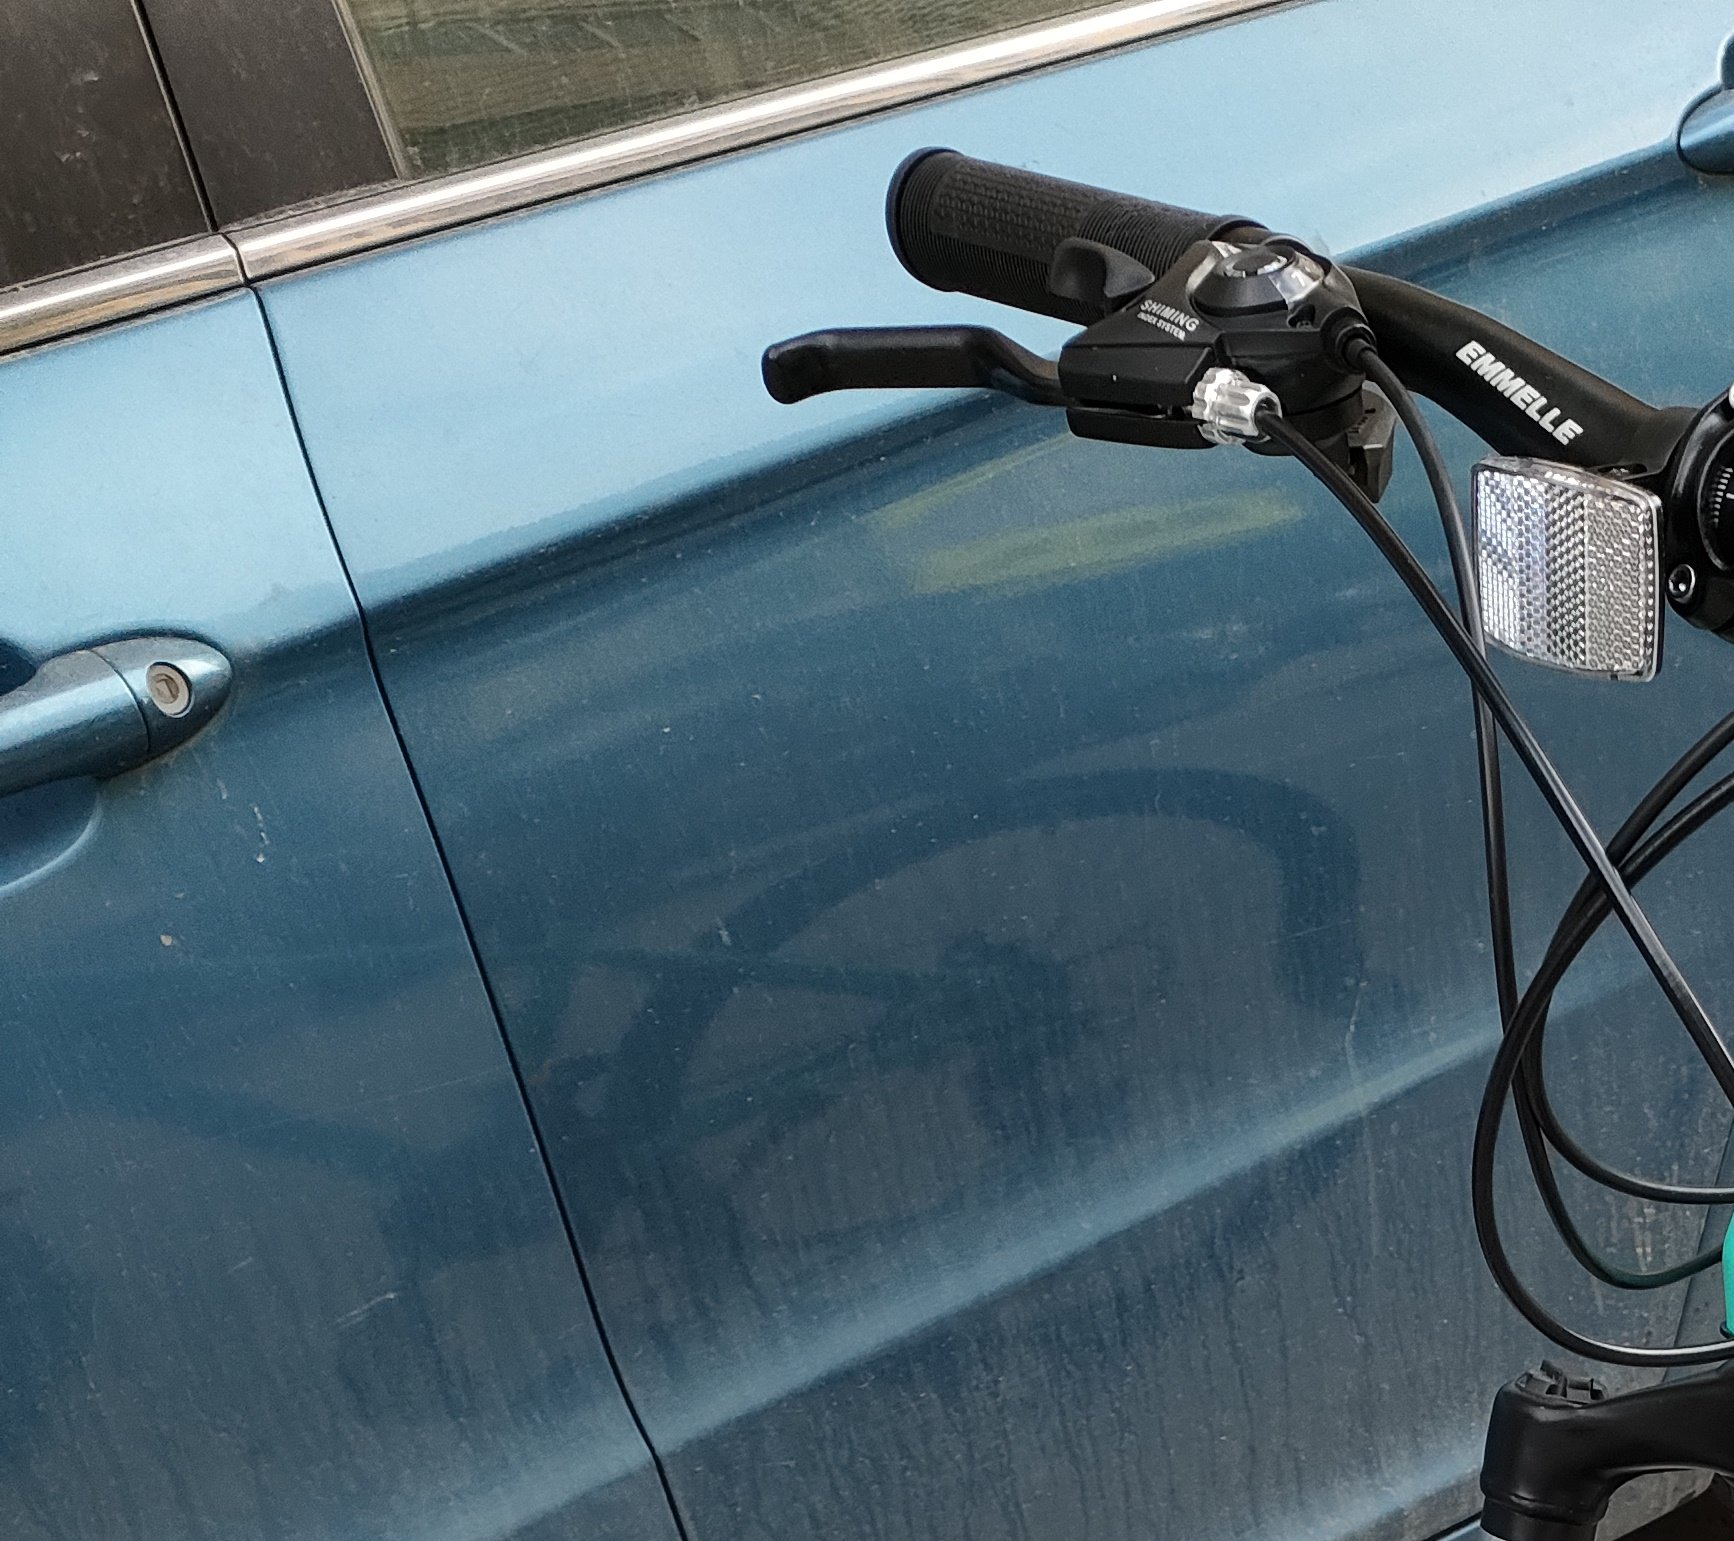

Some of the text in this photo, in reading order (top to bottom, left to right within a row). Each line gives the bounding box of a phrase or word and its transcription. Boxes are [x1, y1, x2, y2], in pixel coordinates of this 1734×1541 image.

[1139, 299, 1200, 332] SHIMING
[1156, 318, 1187, 342] SYSTEM
[1455, 340, 1584, 446] EMMELLE
